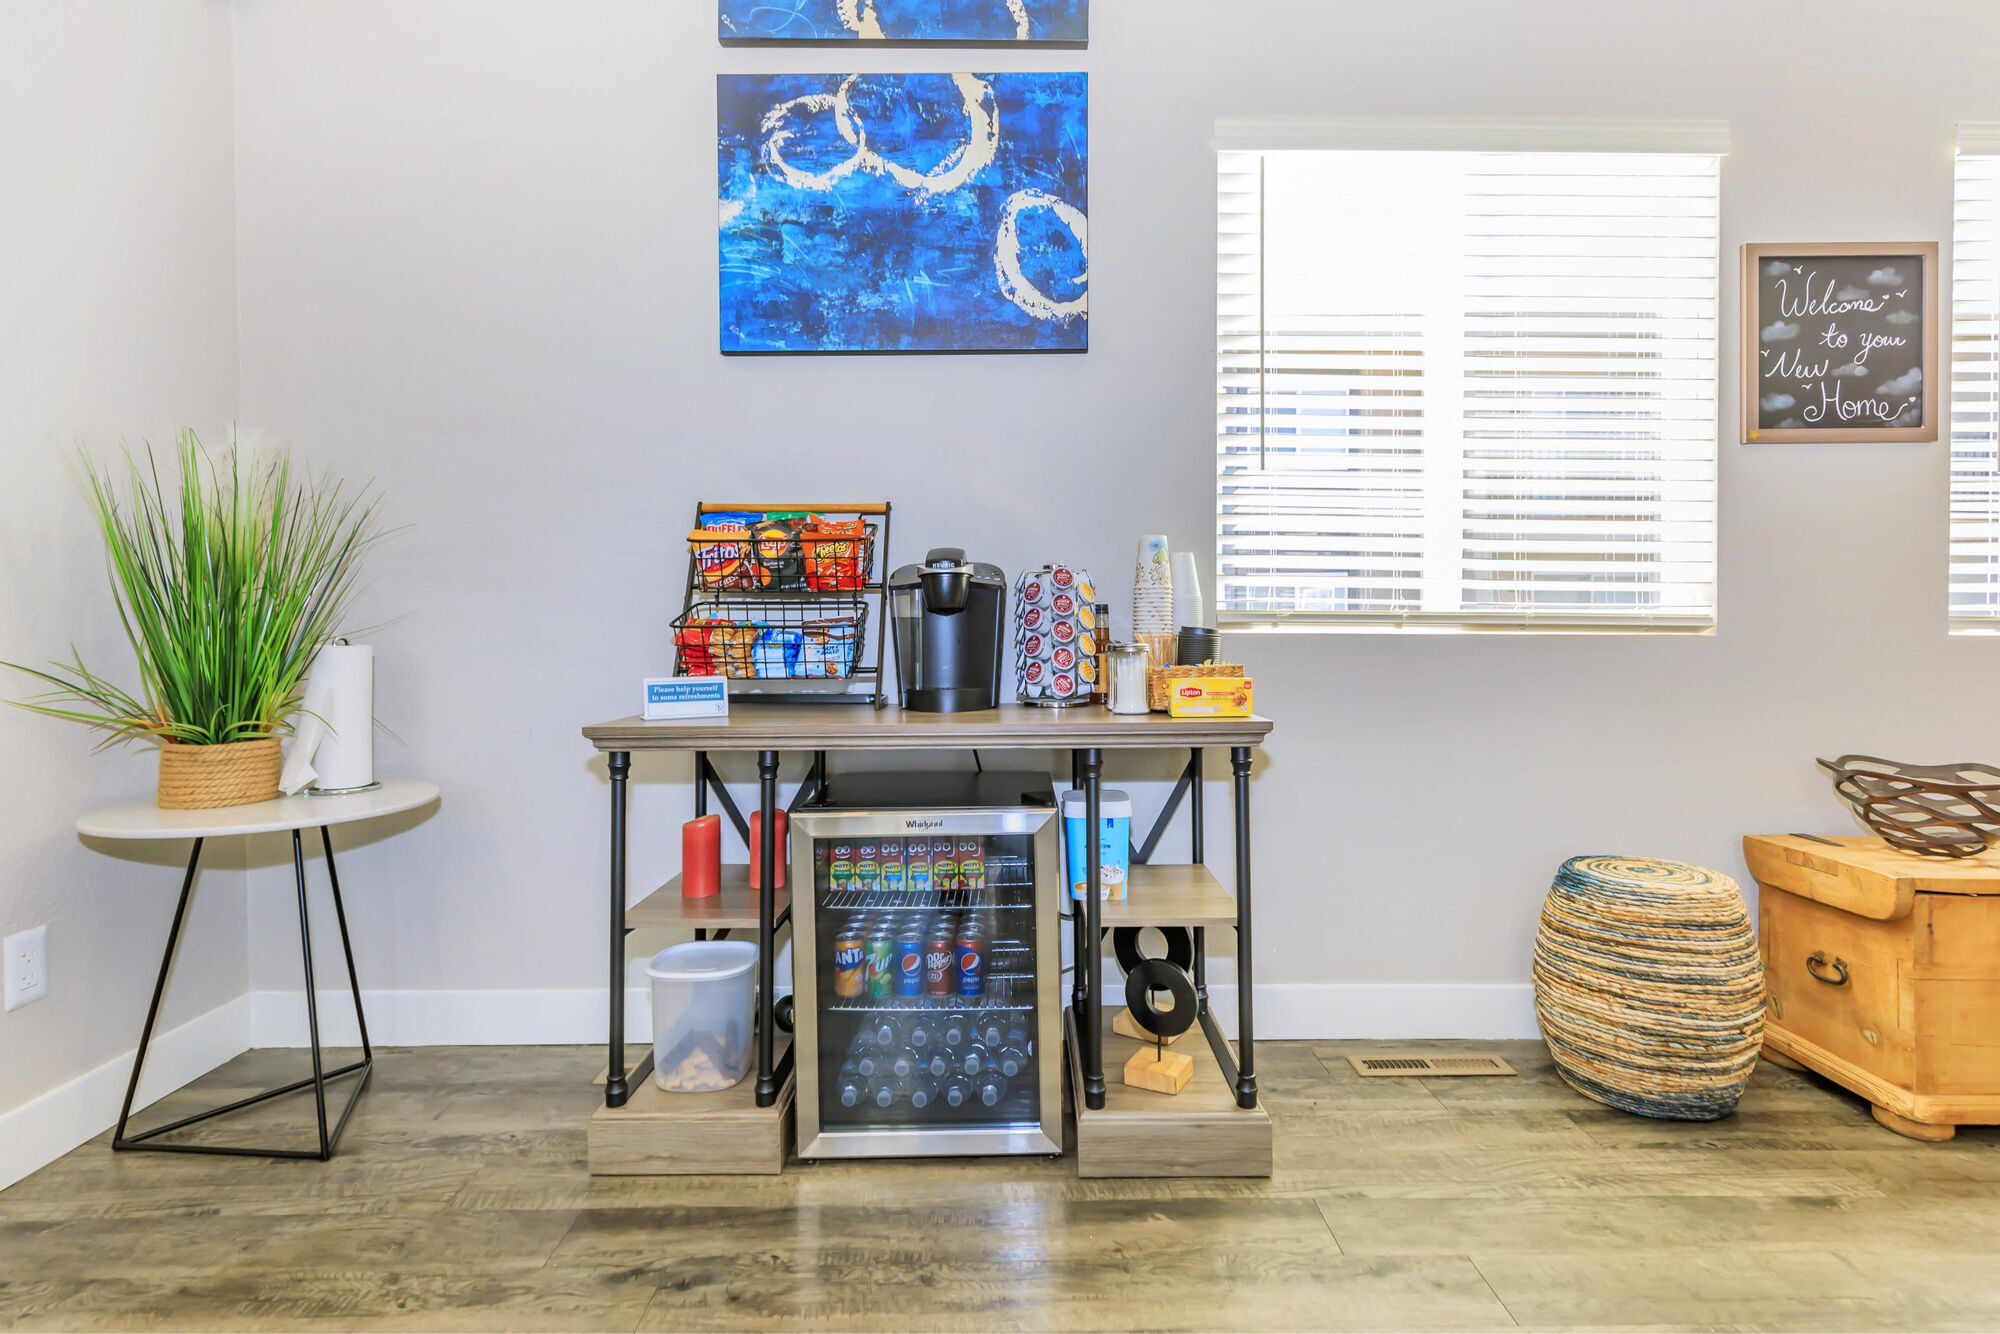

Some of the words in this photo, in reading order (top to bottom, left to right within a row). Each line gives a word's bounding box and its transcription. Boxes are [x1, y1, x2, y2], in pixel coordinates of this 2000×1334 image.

[1775, 271, 1885, 317] Welcome
[1819, 322, 1848, 348] to
[1854, 333, 1907, 364] your
[1765, 348, 1829, 379] New
[1803, 379, 1909, 422] Home
[676, 685, 691, 694] help
[692, 684, 718, 694] yourself
[1181, 689, 1201, 697] Lipton
[905, 819, 943, 830] Whirlpool
